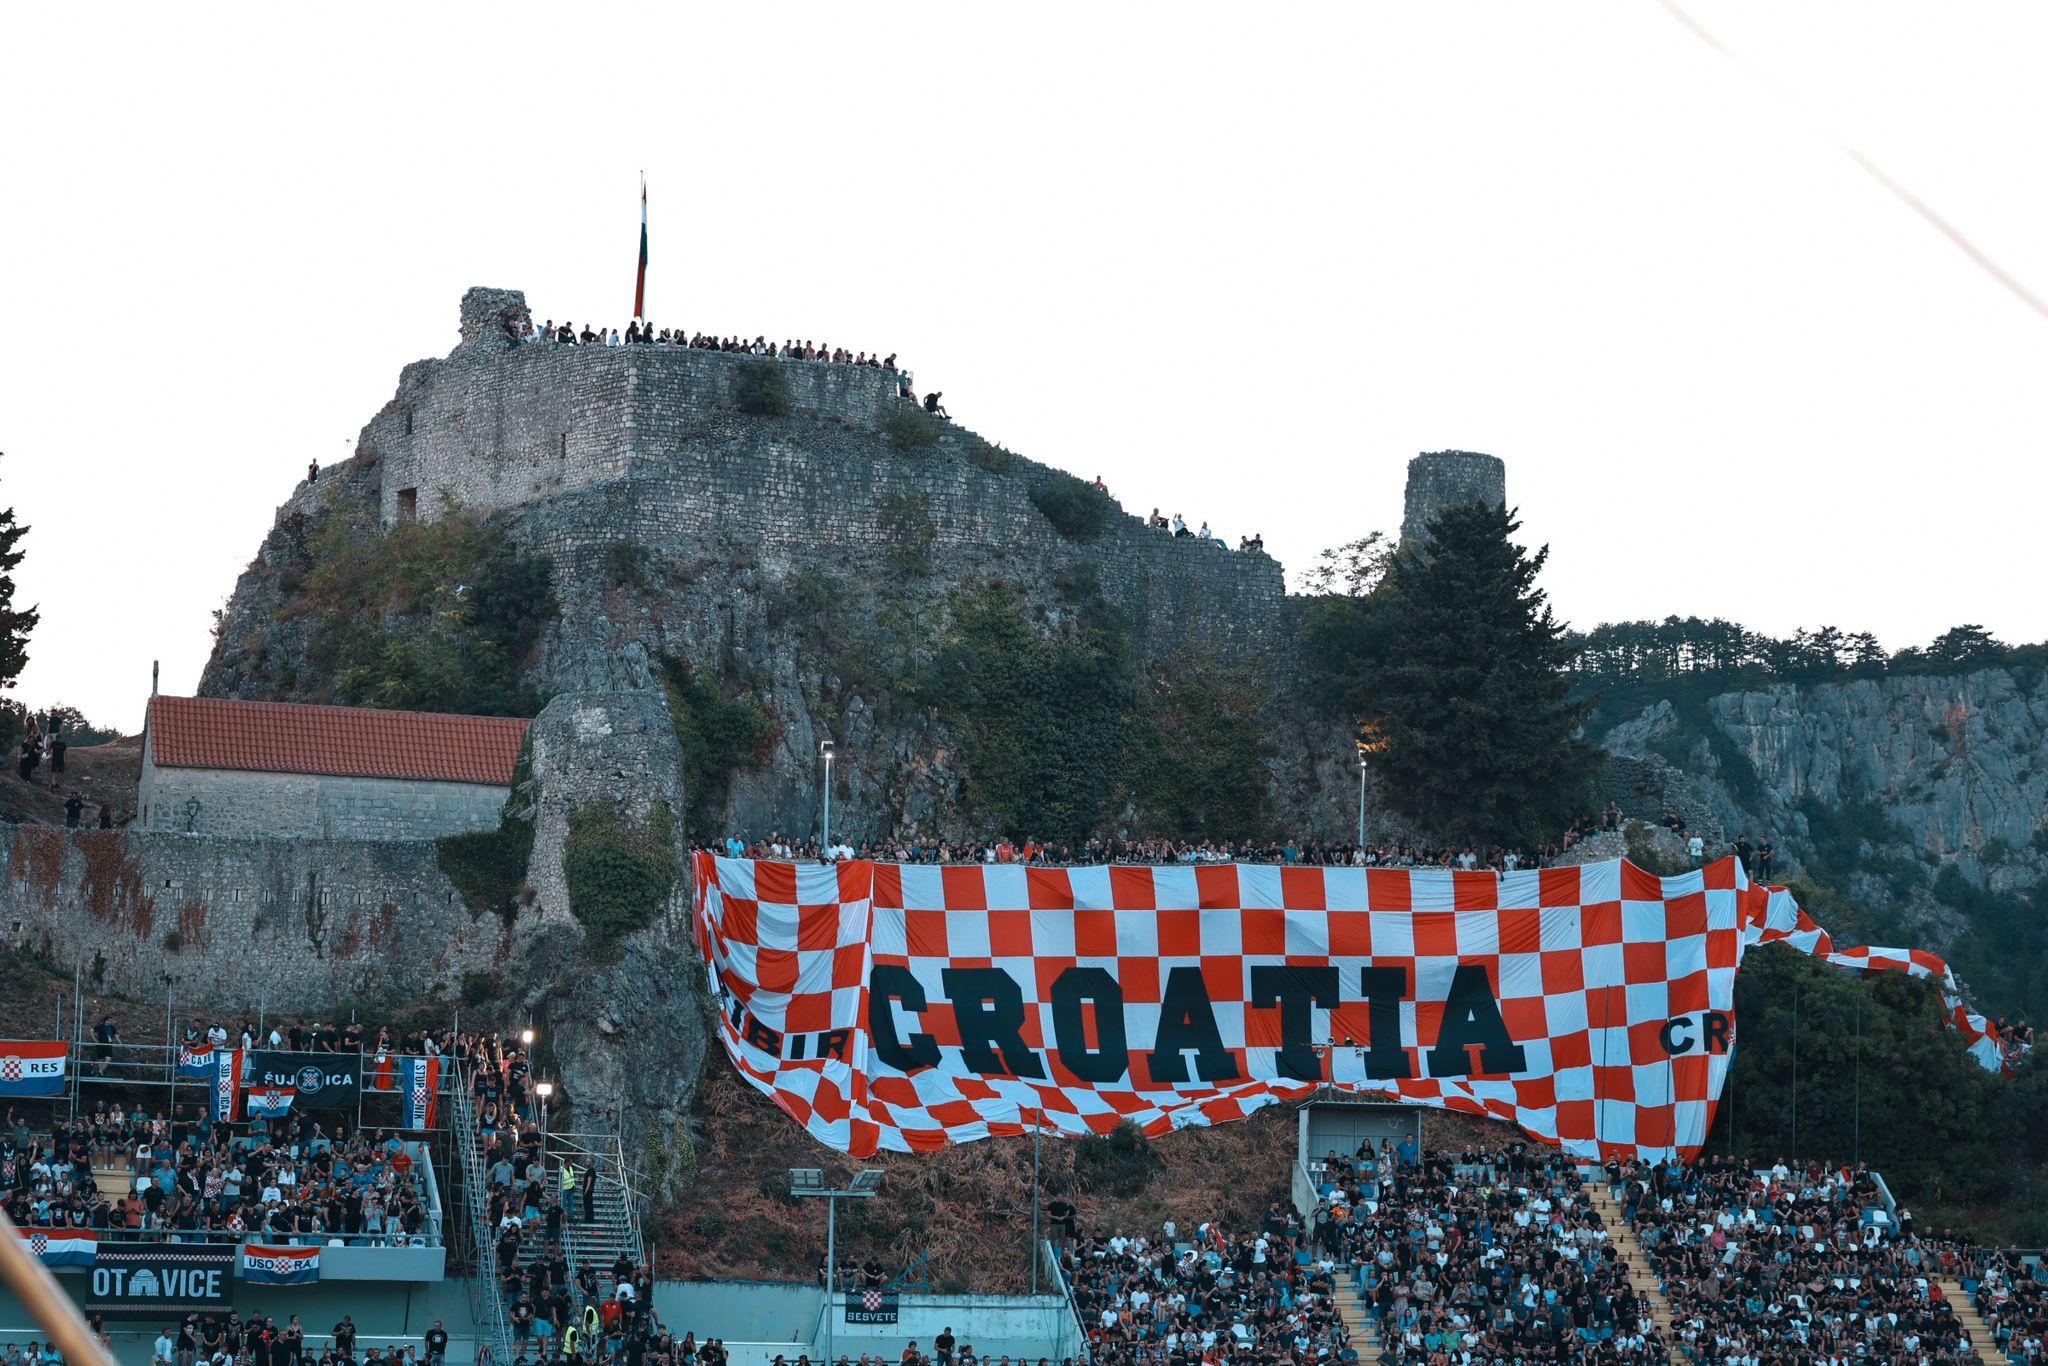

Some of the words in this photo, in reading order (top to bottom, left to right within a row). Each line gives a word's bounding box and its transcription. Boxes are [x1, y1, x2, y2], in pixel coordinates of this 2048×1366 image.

[869, 964, 1527, 1083] CROATIA
[31, 1063, 58, 1073] RES
[325, 1074, 353, 1085] ICA
[415, 1064, 426, 1088] STUP
[414, 1104, 425, 1120] NIK
[248, 1257, 275, 1269] USO
[294, 1260, 312, 1269] RA
[93, 1268, 127, 1297] OT
[162, 1268, 222, 1298] VICE
[847, 1312, 897, 1322] SESVETE
